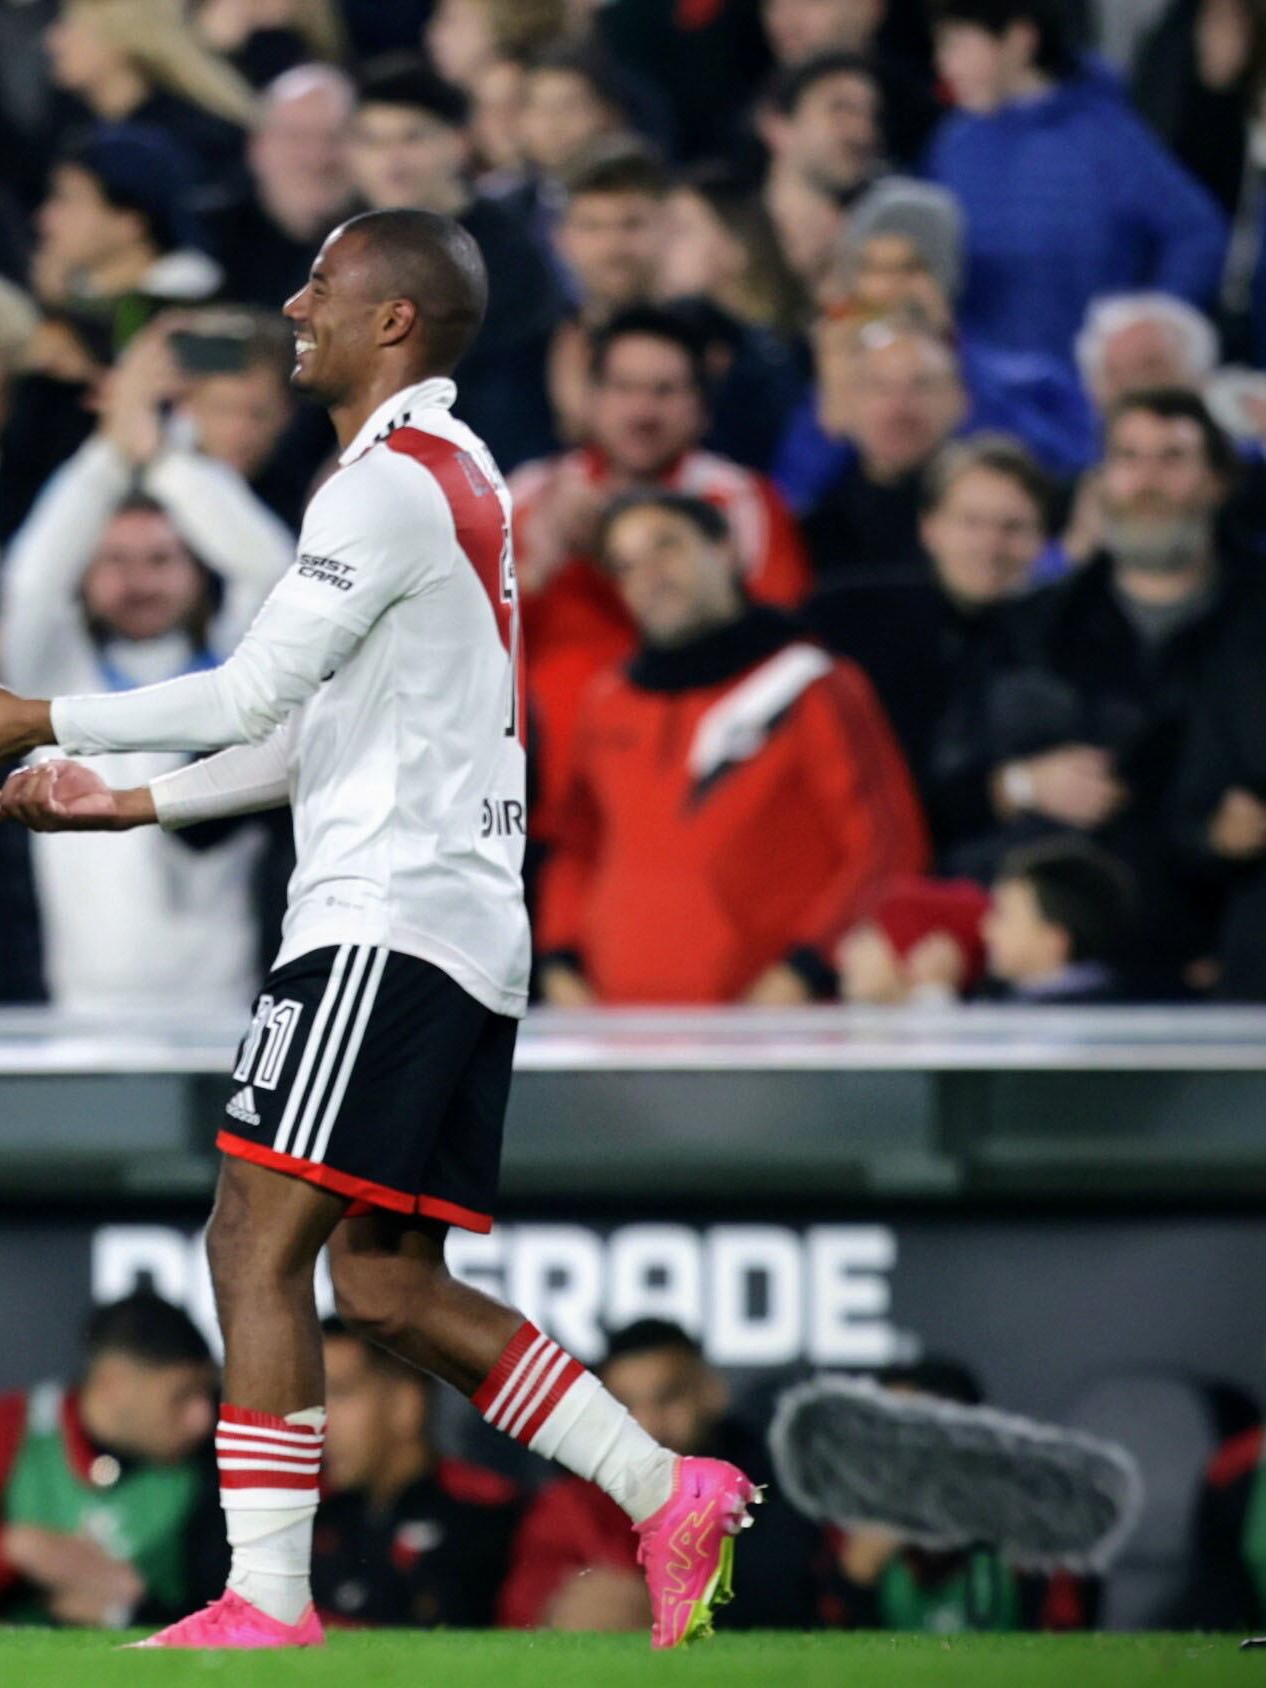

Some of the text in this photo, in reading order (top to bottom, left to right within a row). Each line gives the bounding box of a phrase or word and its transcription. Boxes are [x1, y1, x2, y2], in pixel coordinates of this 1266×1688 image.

[298, 566, 353, 592] CARD
[300, 554, 357, 576] SSIST
[480, 798, 526, 839] DIR
[233, 994, 304, 1091] 11
[91, 1223, 896, 1367] PERADE
